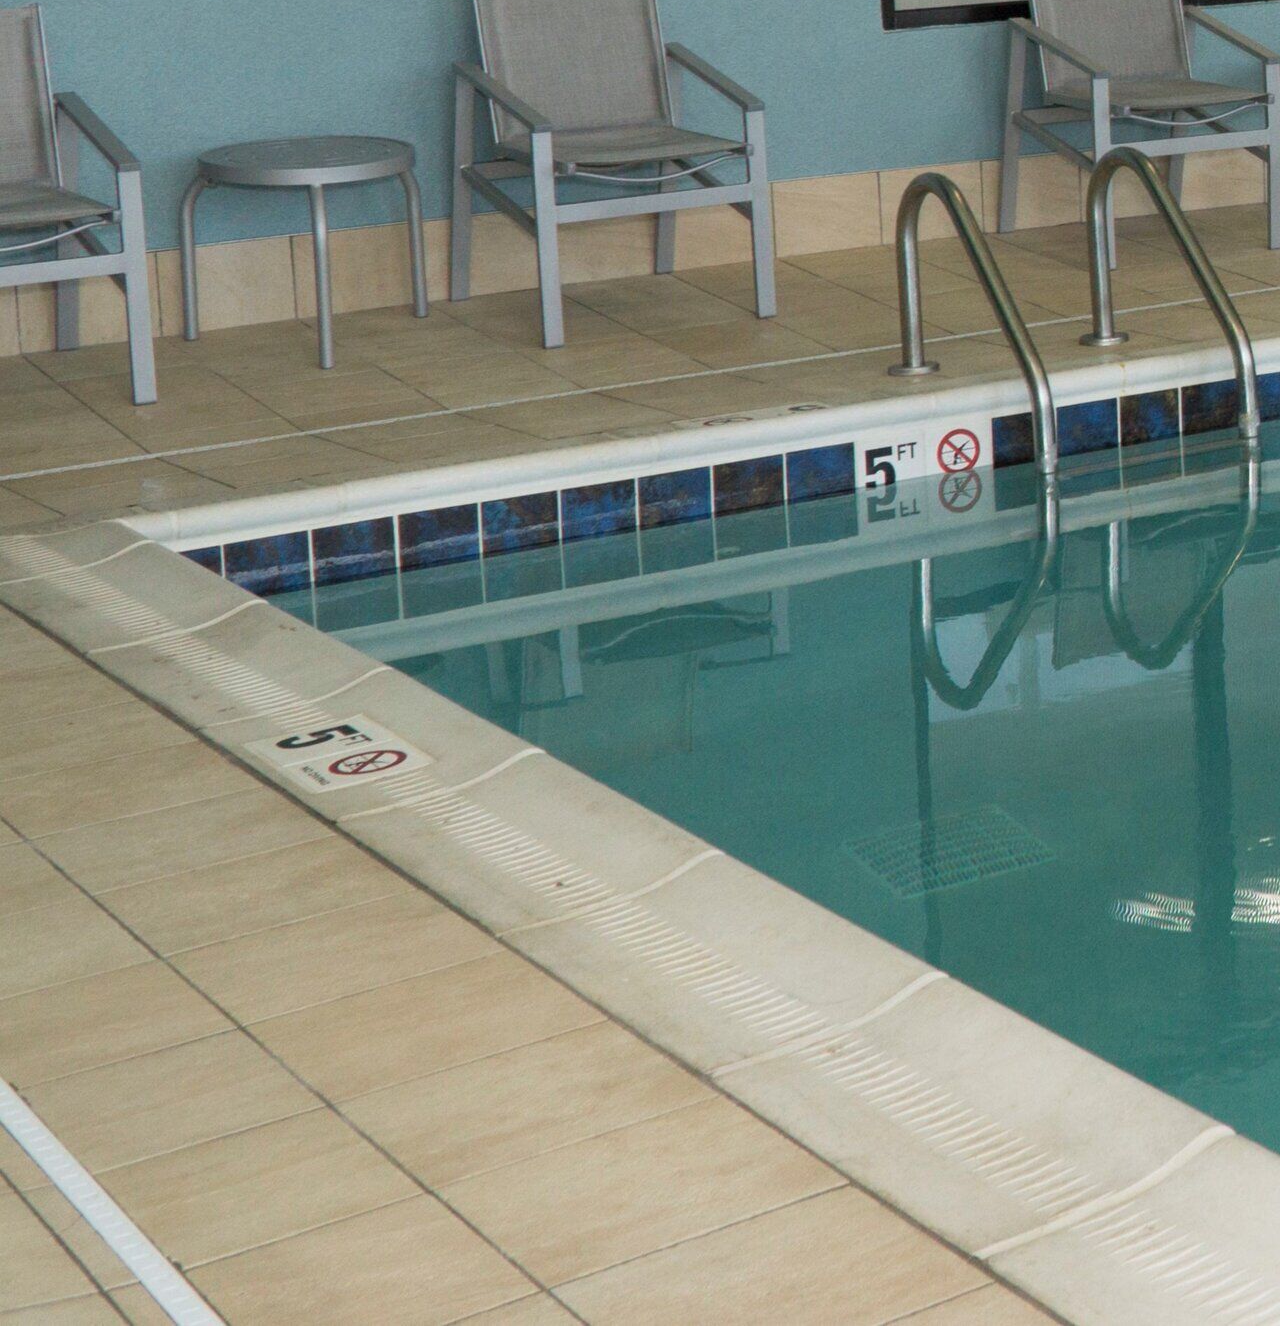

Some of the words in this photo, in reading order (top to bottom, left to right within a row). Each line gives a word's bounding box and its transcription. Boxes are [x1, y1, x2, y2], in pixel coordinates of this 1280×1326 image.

[864, 446, 897, 489] 5
[897, 442, 918, 461] FT
[275, 724, 361, 750] 5
[337, 732, 373, 747] FT
